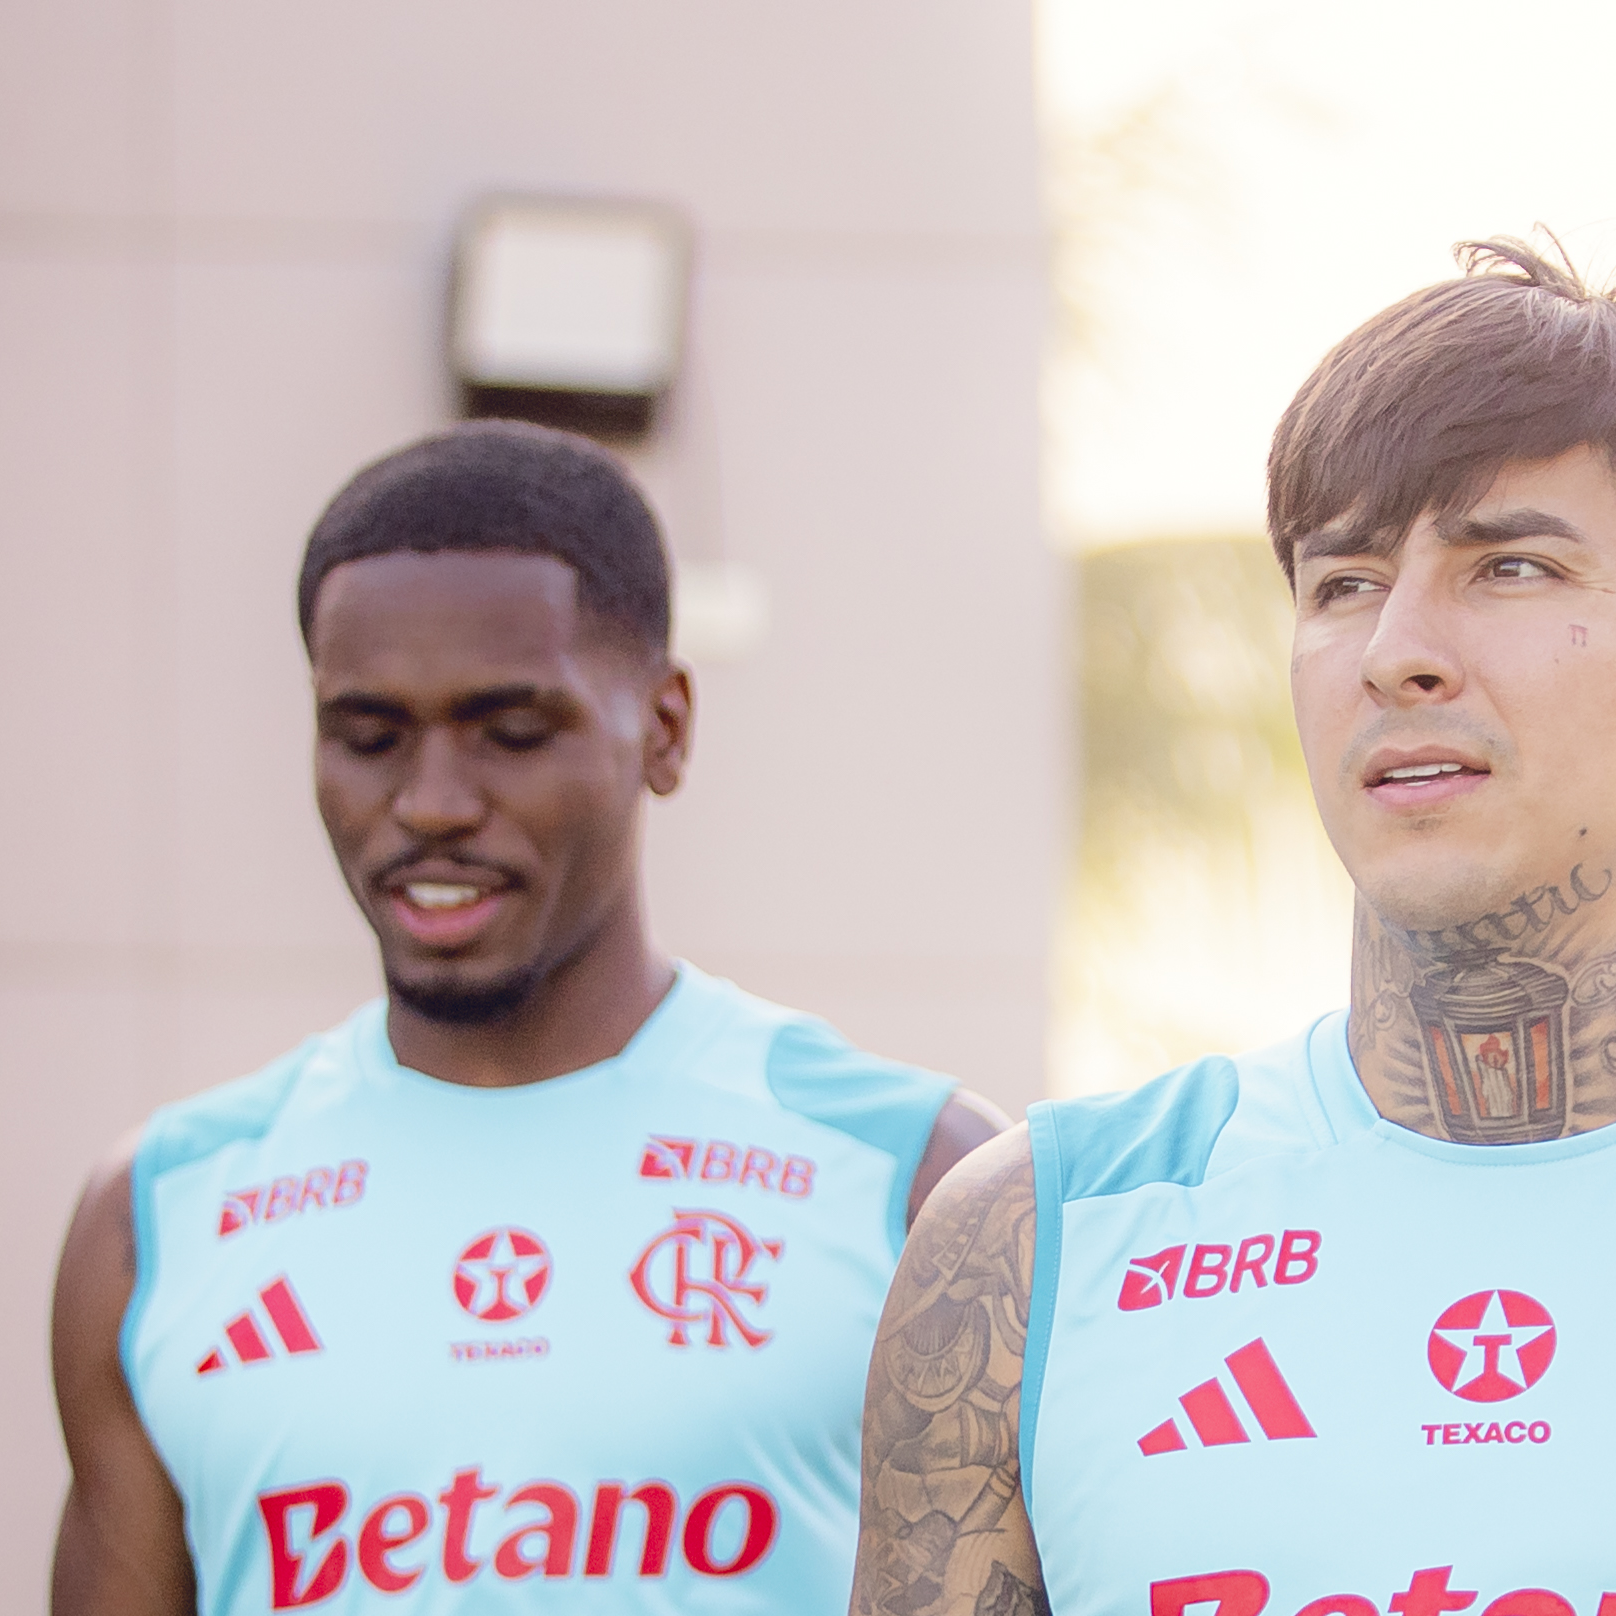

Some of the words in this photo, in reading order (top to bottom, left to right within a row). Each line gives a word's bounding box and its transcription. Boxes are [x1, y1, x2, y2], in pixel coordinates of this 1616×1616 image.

[264, 1160, 369, 1222] BRB
[699, 1141, 816, 1199] BRB
[1184, 1229, 1323, 1300] BRB
[1421, 1420, 1552, 1446] TEXACO
[257, 1465, 781, 1614] Betano
